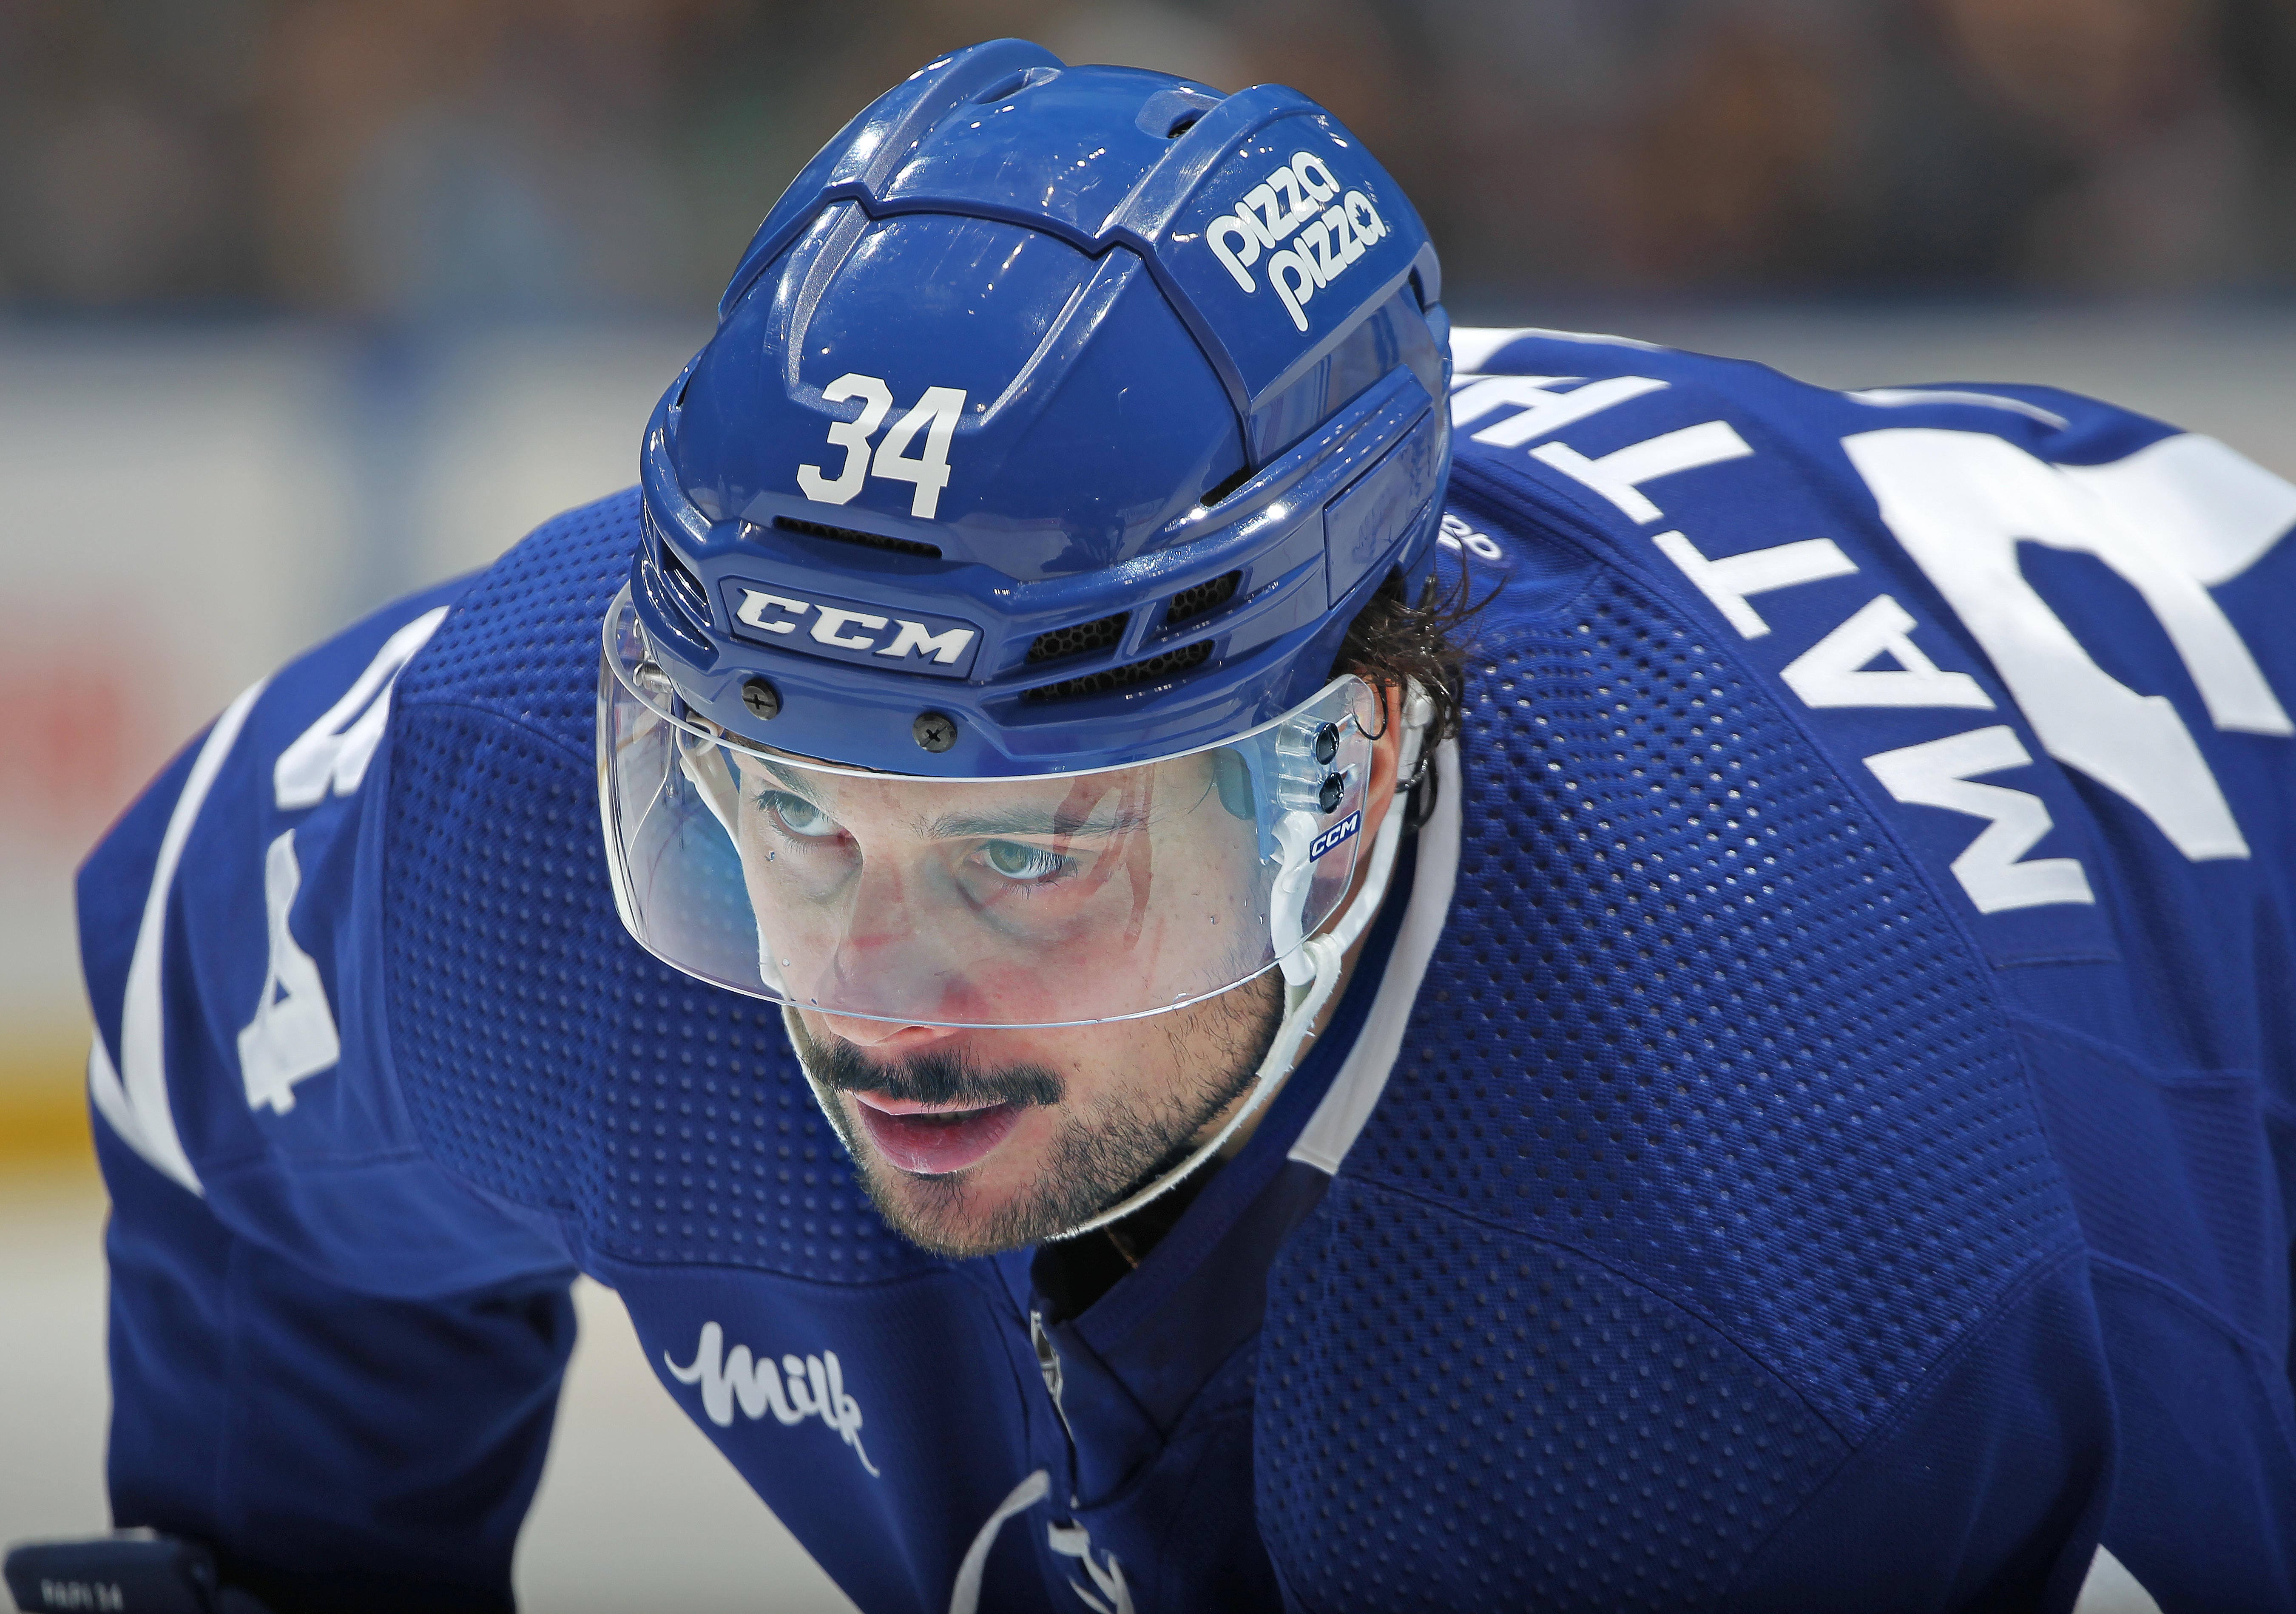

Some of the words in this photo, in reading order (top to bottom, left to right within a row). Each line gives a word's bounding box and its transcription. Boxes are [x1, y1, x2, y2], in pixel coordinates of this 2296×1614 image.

[1206, 151, 1340, 293] pizza
[1267, 190, 1386, 332] pizza
[796, 372, 967, 519] 34
[736, 589, 975, 664] CCM
[1449, 373, 2096, 915] MATTH
[1311, 814, 1357, 857] CCM
[664, 1321, 880, 1478] Milk
